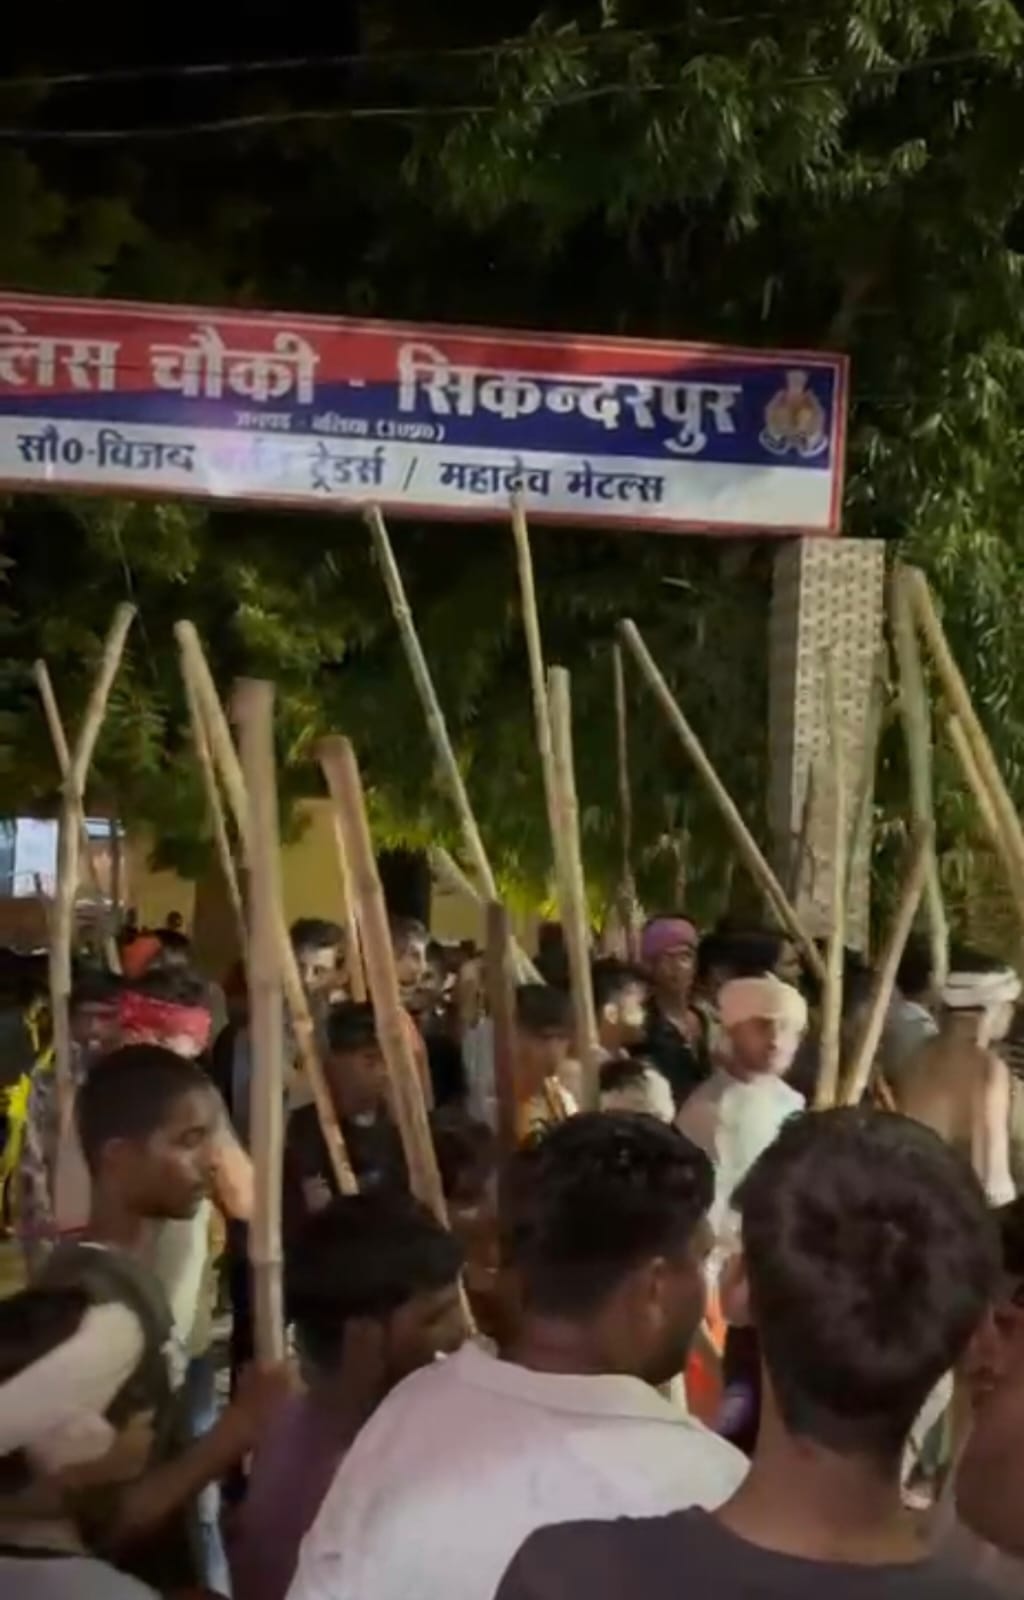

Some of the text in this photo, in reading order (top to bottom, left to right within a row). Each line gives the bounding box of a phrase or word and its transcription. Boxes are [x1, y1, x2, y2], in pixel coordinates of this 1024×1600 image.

[150, 325, 319, 403] चौकी
[397, 343, 742, 454] सिकन्दरपुर
[309, 442, 386, 492] ट्रेडर्स
[403, 457, 418, 492] /
[439, 456, 550, 496] महादेव
[565, 459, 665, 502] मेटल्स
